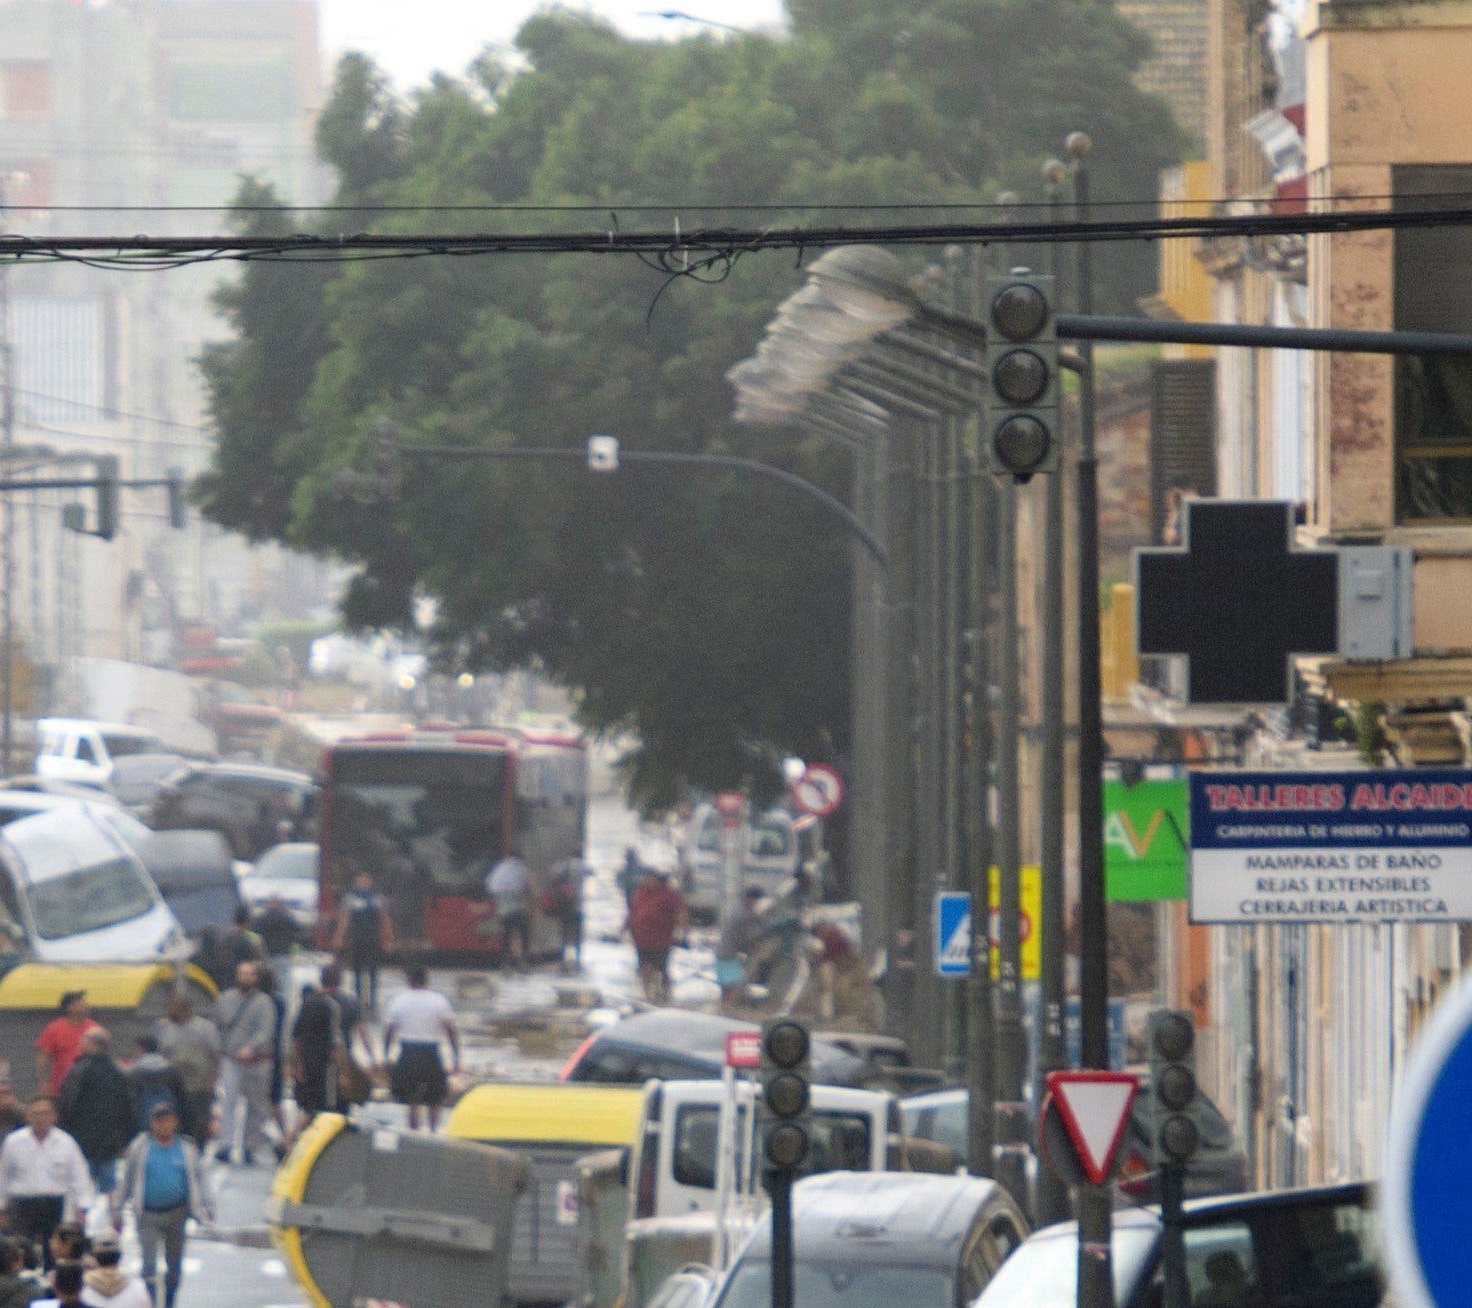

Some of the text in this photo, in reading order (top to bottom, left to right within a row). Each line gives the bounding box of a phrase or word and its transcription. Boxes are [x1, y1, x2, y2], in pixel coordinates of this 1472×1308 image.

[1206, 784, 1344, 811] TALLERES
[1309, 825, 1327, 838] DE
[1330, 825, 1382, 838] HIERRO
[1386, 825, 1395, 838] Y
[1398, 824, 1470, 838] ALUMINIO
[1245, 850, 1442, 870] MAMPARAS DE BAÑO
[1256, 877, 1431, 893] REJAS EXTENSIBLES
